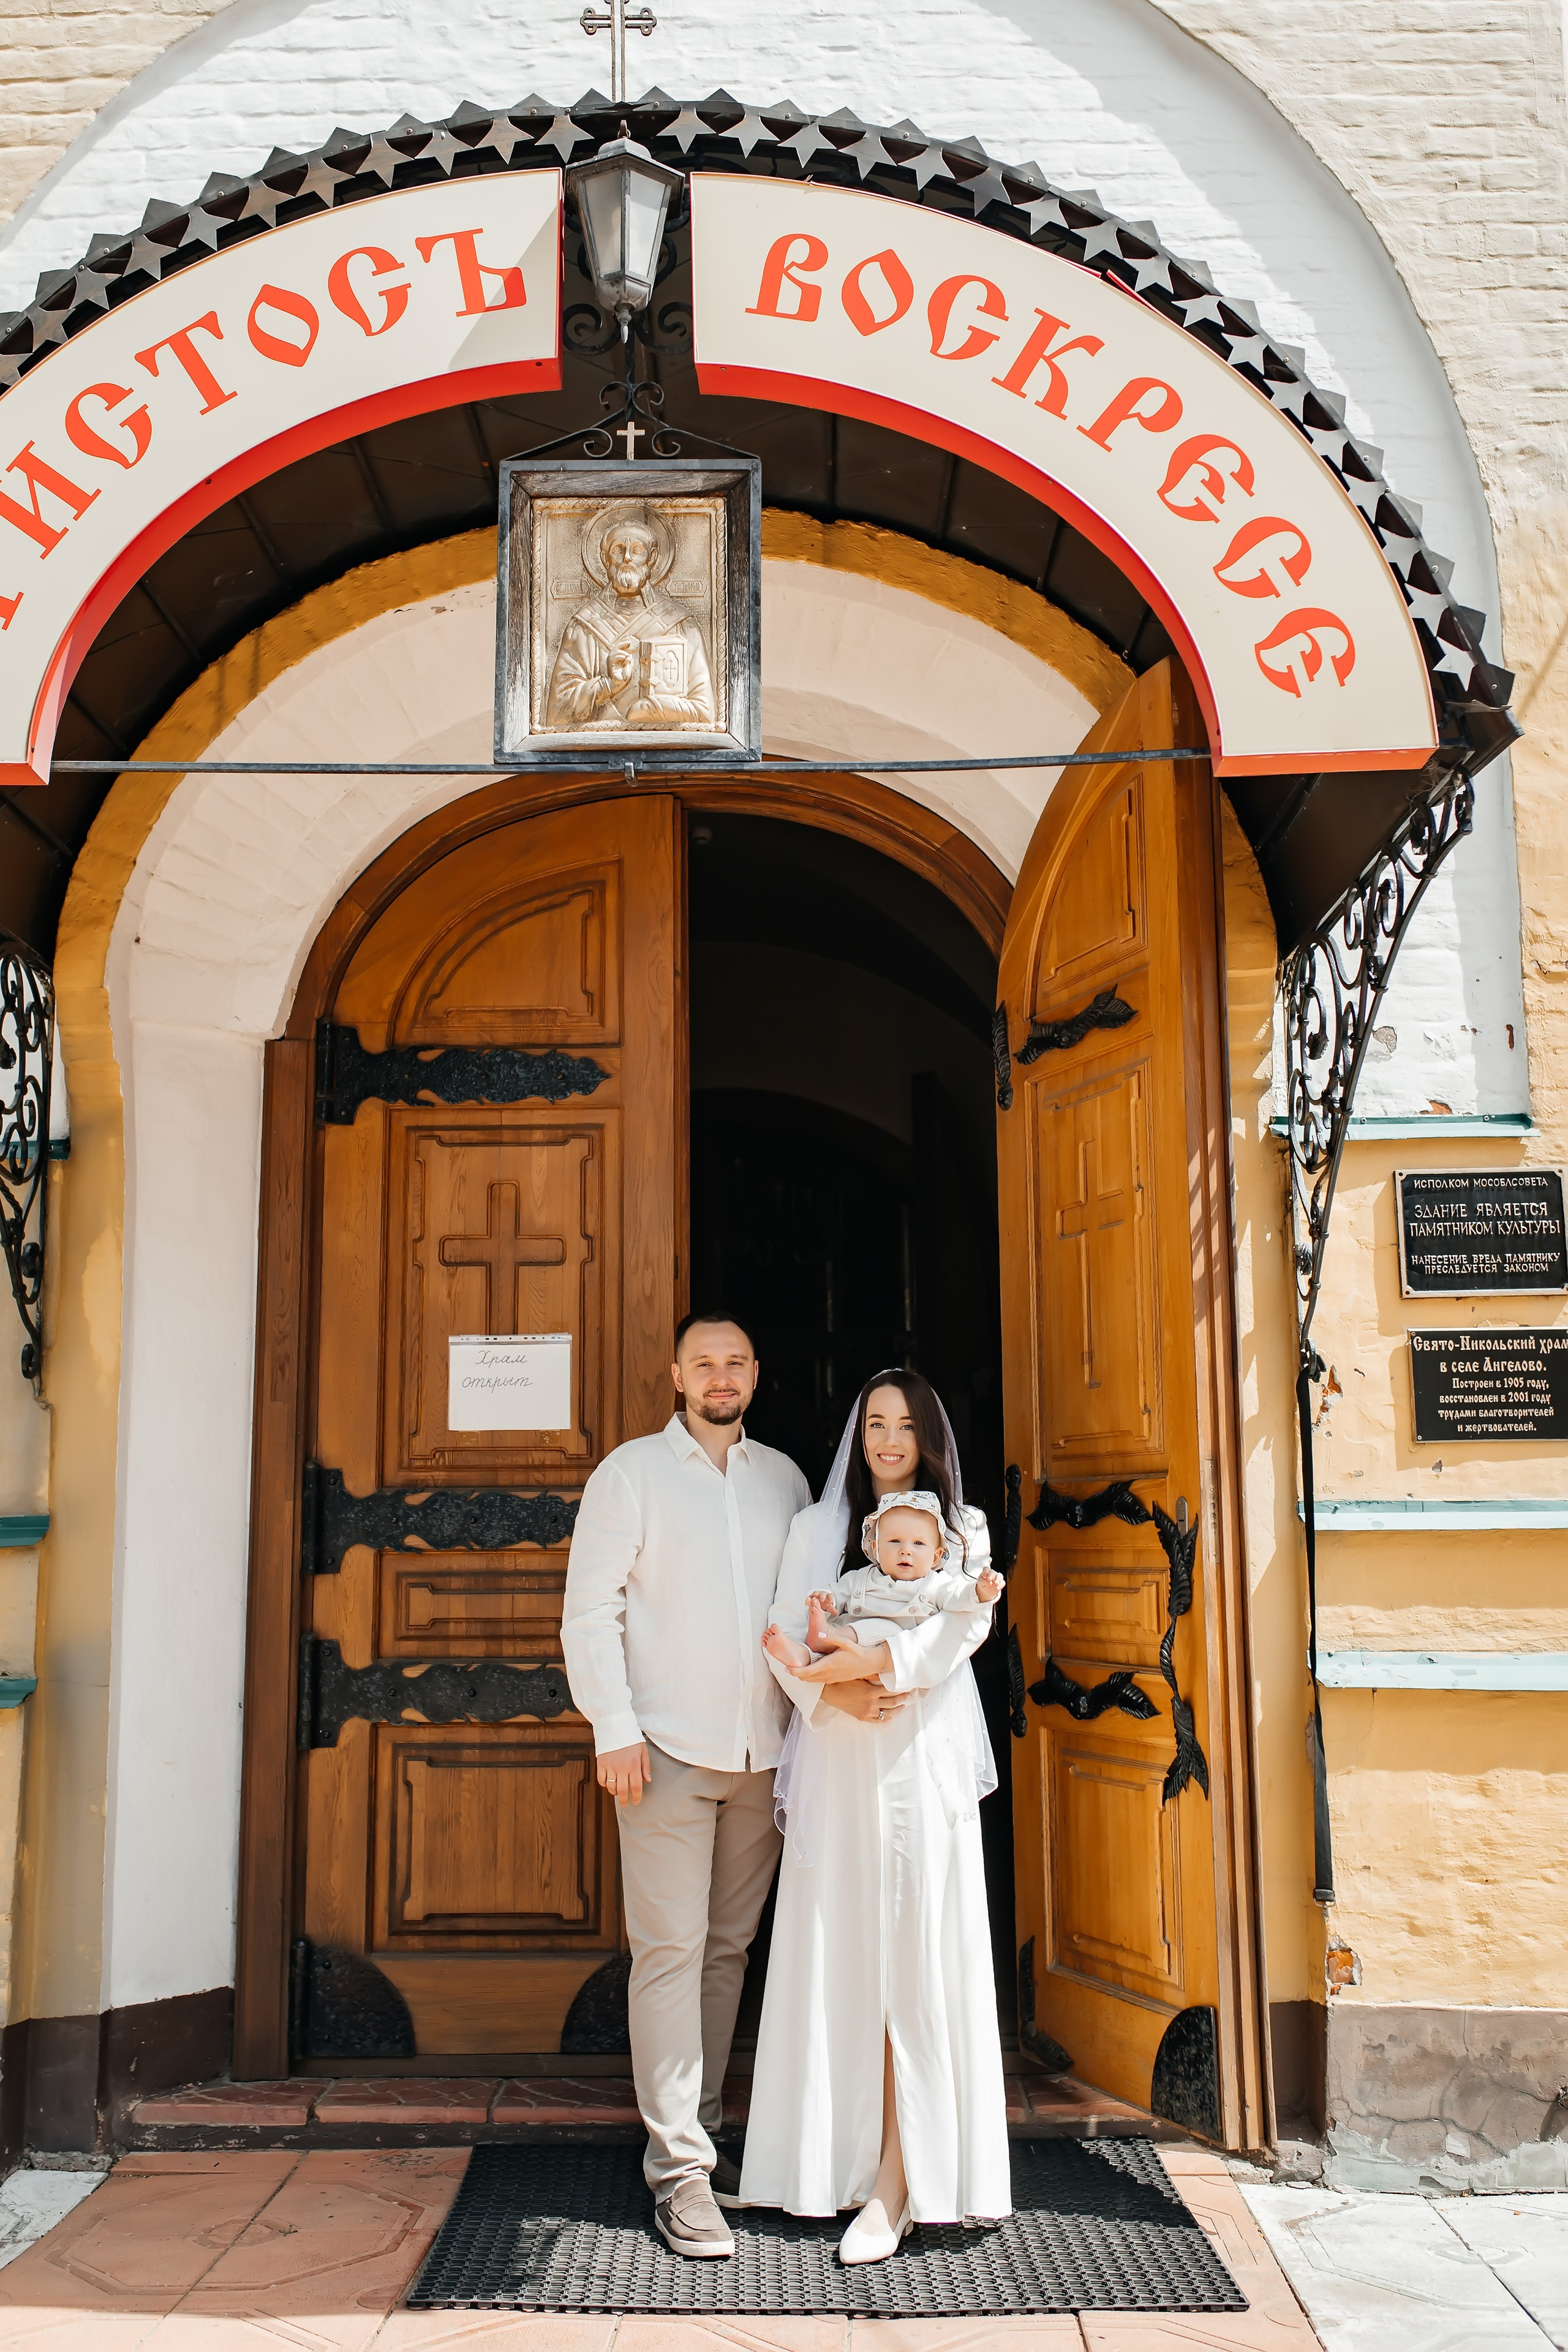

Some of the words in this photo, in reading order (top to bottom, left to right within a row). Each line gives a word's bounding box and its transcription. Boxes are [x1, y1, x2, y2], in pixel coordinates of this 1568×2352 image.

[0, 228, 527, 630] ИСТОСЪ
[745, 233, 1355, 698] ВОСКРЕСЕ
[1414, 1179, 1468, 1188] ИСПОЛКОМ
[1474, 1177, 1548, 1187] МОСОБЛСОВЕТА
[1415, 1204, 1467, 1218] ЗДАНИЕ
[1477, 1202, 1547, 1216] ЯВЛЯЕТСЯ
[1409, 1221, 1493, 1236] ПАМЯТНИКОМ
[1497, 1220, 1559, 1234] КУЛЬТУРЫ
[1411, 1255, 1469, 1265] НАНЕСЕНИЕ
[1472, 1254, 1502, 1263] ВРЕДА
[1505, 1253, 1560, 1262] ПАМЯТНИКУ
[1425, 1264, 1497, 1274] ПРЕСЛЕДУЕТСЯ
[1504, 1263, 1548, 1272] ЗАКОНОМ
[1413, 1335, 1536, 1351] Свято-Никольский
[475, 1350, 527, 1368] Храм
[1441, 1362, 1447, 1372] в
[1452, 1362, 1479, 1373] селе
[1483, 1357, 1546, 1371] Ангелово.
[462, 1376, 533, 1393] открыт
[1452, 1378, 1493, 1390] Построен
[1504, 1378, 1523, 1387] 1905
[1527, 1379, 1548, 1390] году,
[1440, 1395, 1498, 1403] восстановлен
[1508, 1392, 1529, 1402] 2001
[1532, 1394, 1551, 1404] году
[1438, 1410, 1476, 1420] трудами
[1479, 1407, 1553, 1419] благотворителей
[1465, 1422, 1536, 1434] жертвователей.
